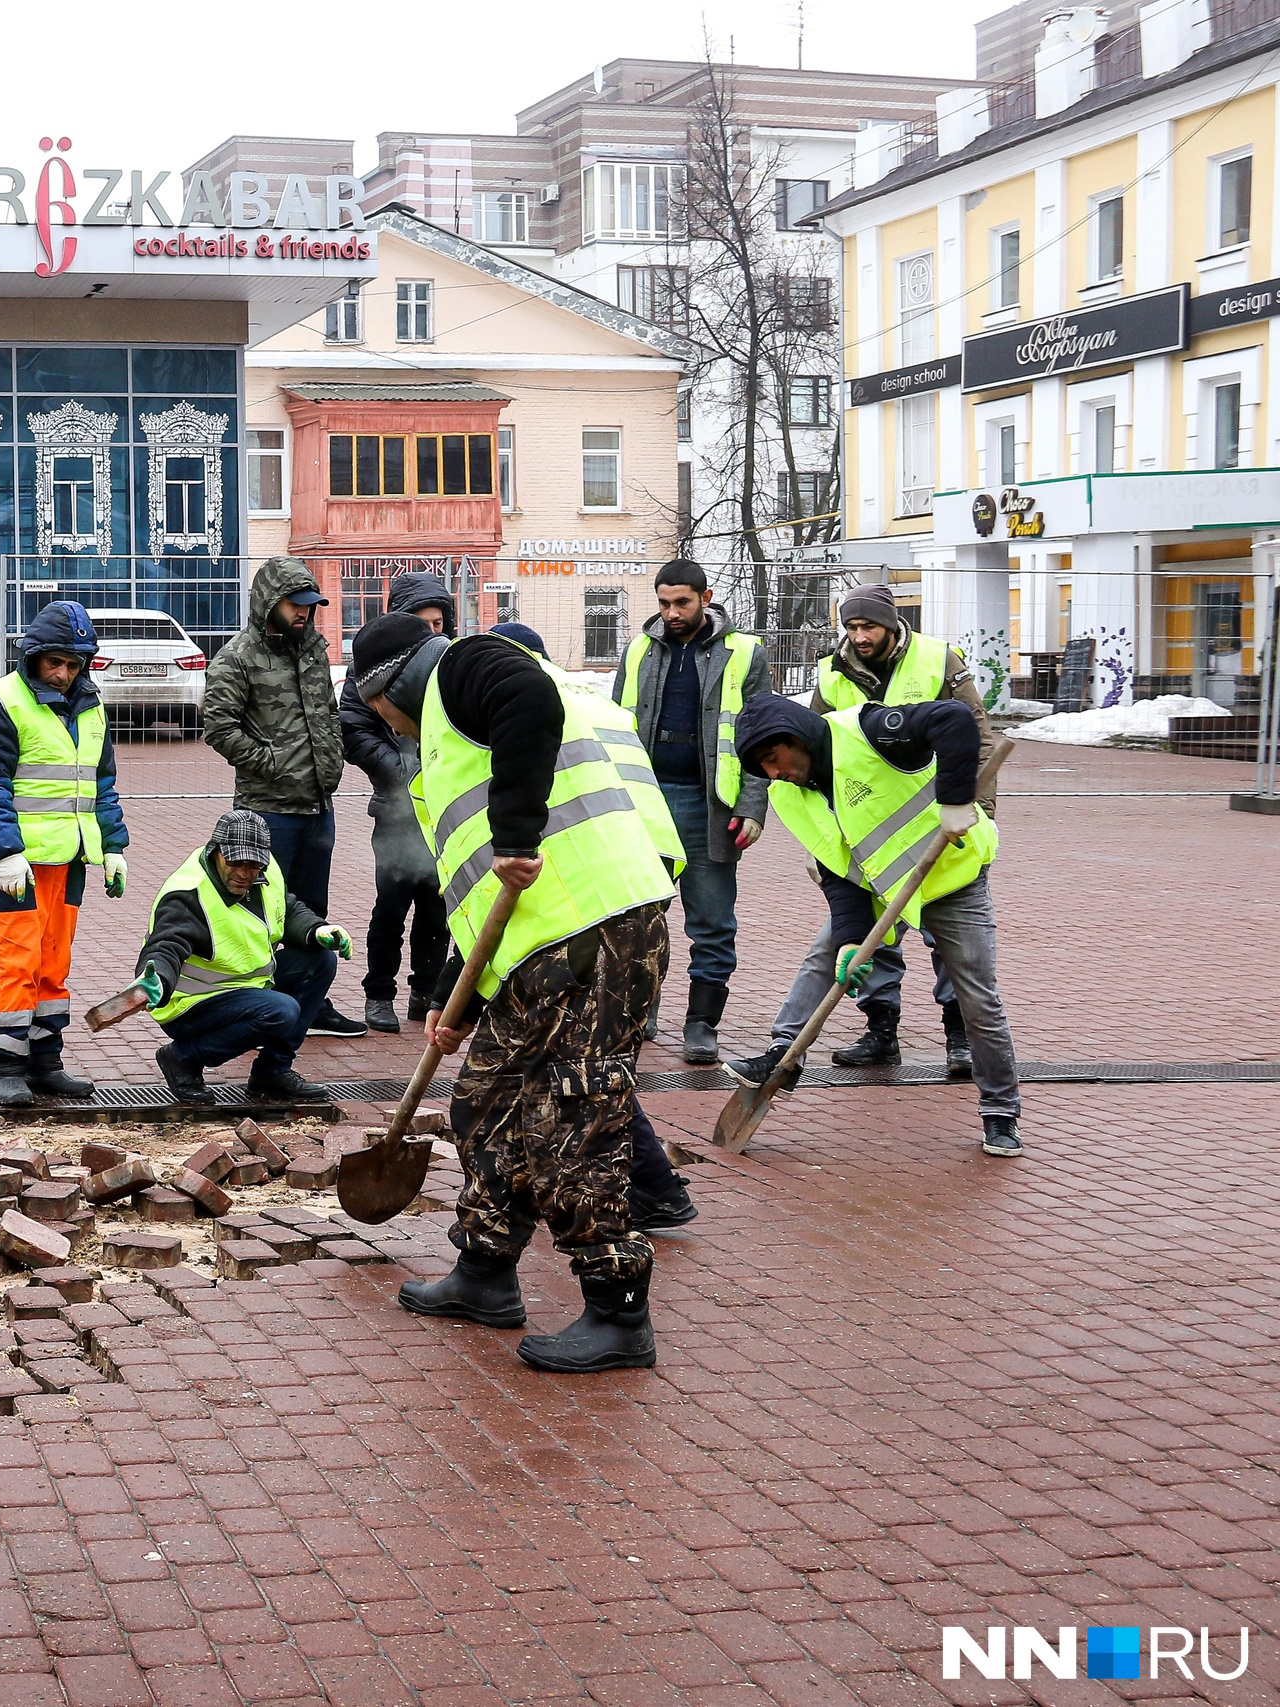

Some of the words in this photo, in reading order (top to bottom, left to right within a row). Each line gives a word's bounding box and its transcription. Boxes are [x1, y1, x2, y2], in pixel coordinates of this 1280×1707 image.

[133, 232, 249, 257] cocktails
[254, 234, 274, 258] &
[279, 235, 371, 260] friends
[1219, 291, 1272, 316] design
[1048, 316, 1078, 343] Olga
[881, 374, 911, 392] design
[913, 364, 946, 385] school
[998, 489, 1033, 514] Choco
[517, 539, 647, 557] ДОМАШНИЕ
